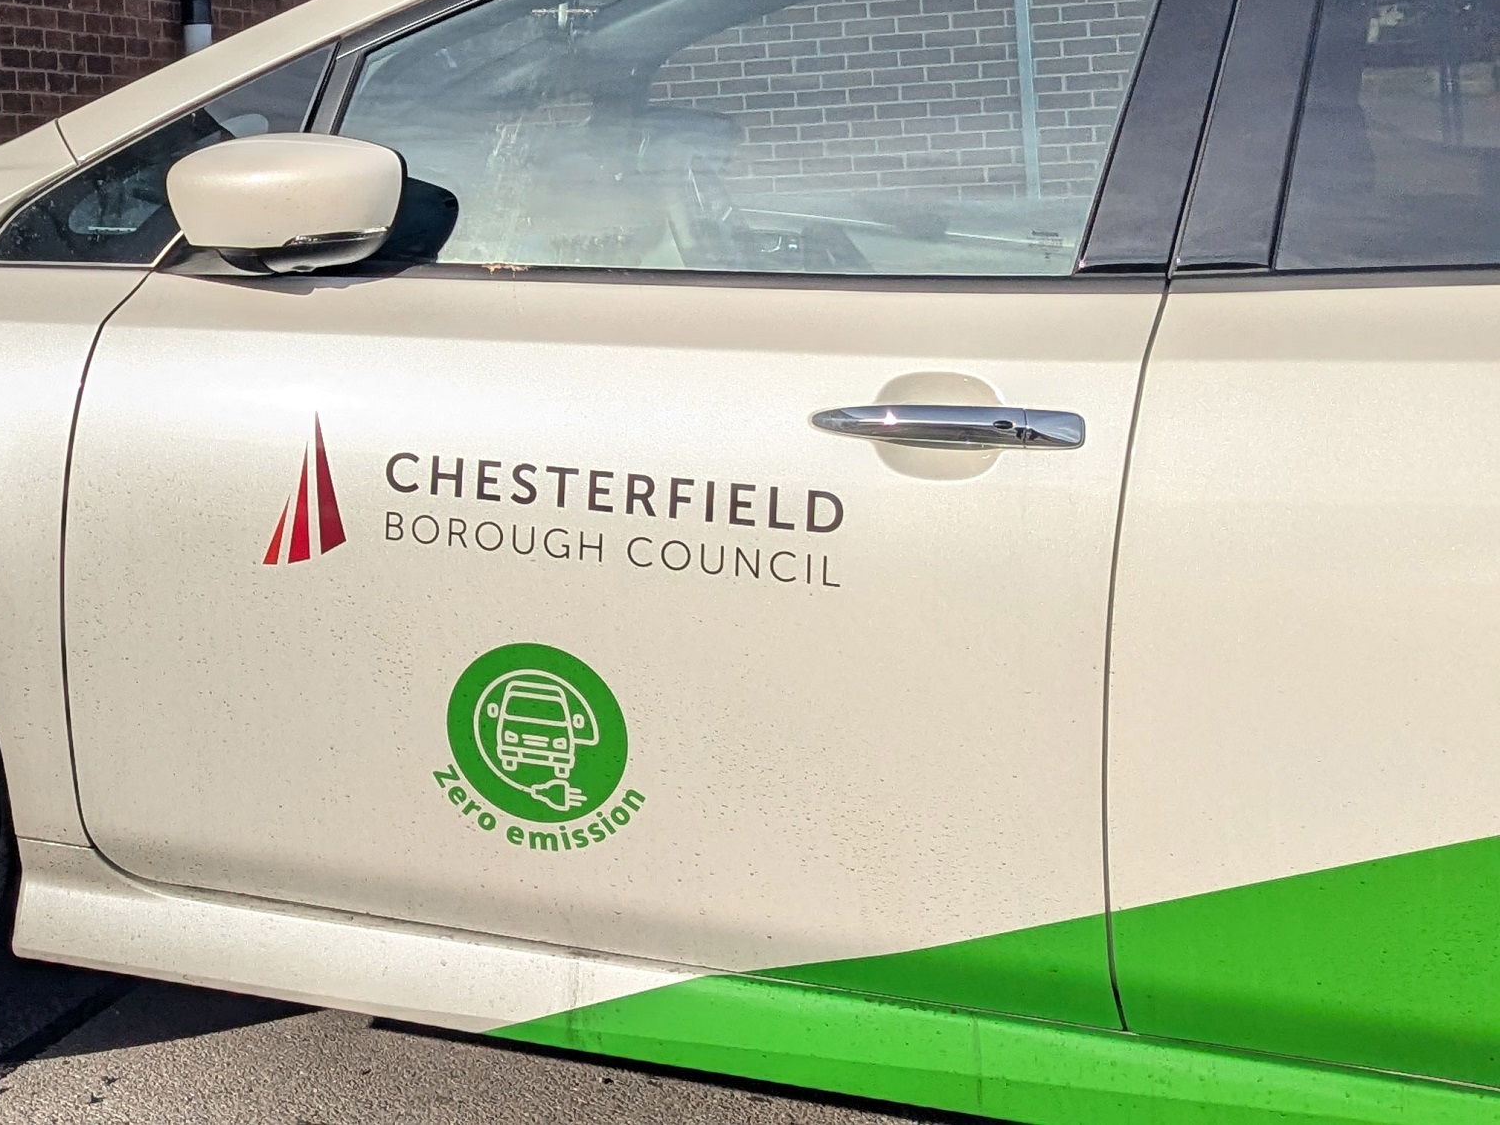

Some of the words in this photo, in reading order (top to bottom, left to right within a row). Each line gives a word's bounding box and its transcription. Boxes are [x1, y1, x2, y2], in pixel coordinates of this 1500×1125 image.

[385, 452, 845, 534] CHESTERFIELD
[384, 511, 604, 564] BOROUGH
[626, 536, 841, 588] COUNCIL
[432, 763, 498, 833] zero
[506, 786, 647, 853] emission
